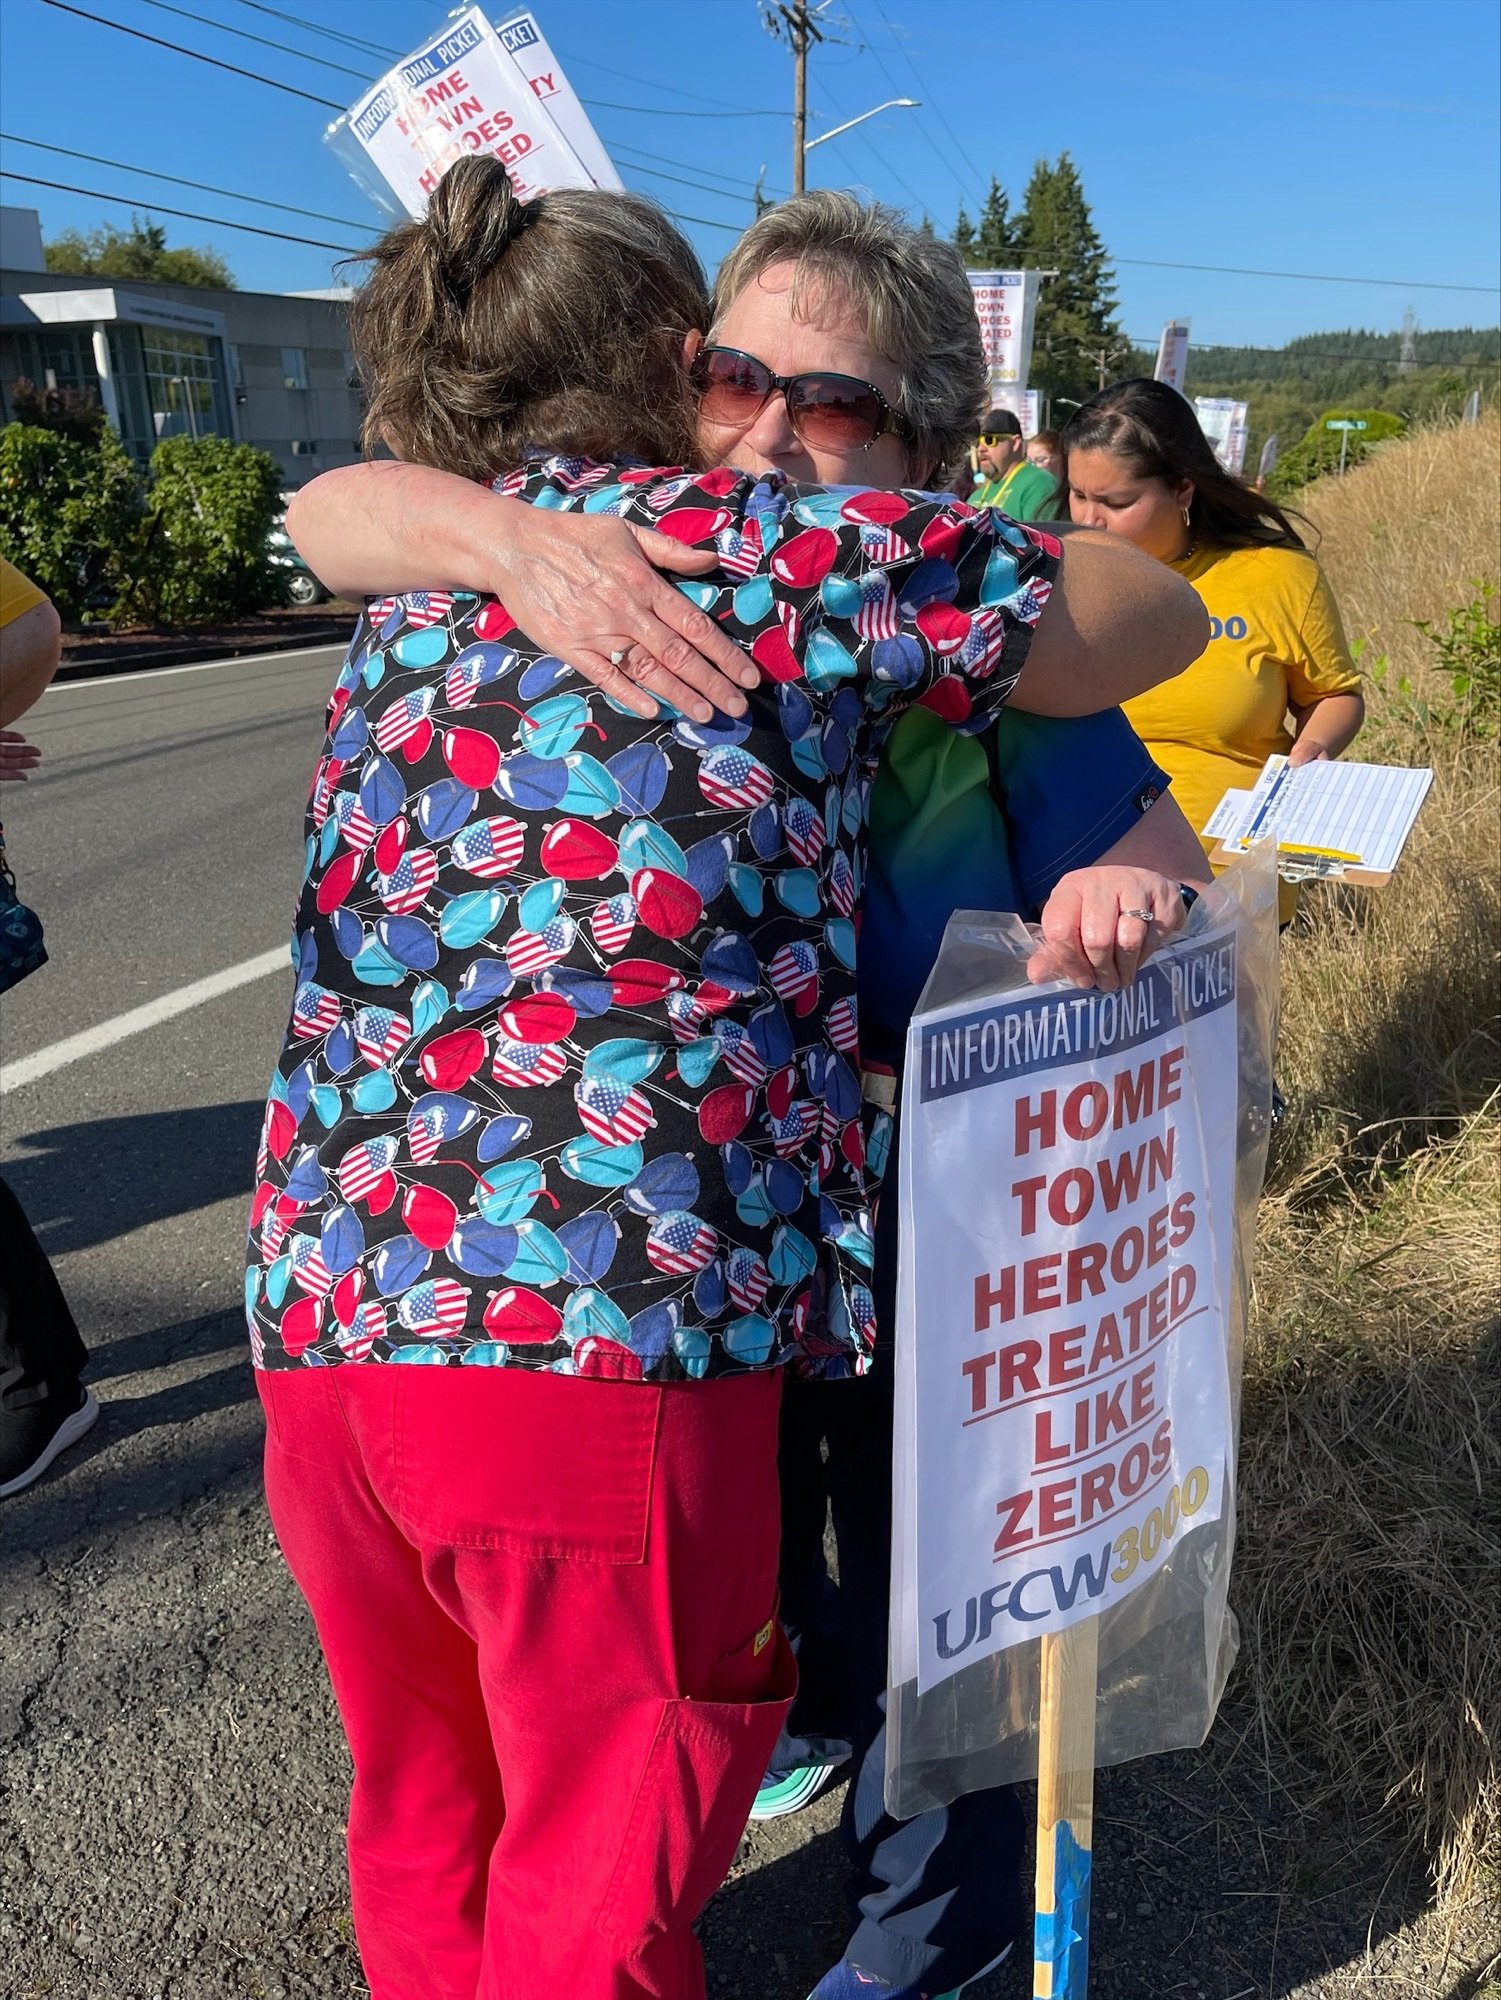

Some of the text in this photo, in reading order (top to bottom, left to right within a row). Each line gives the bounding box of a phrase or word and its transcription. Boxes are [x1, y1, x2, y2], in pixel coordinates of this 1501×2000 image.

[437, 22, 481, 66] PICKET
[502, 21, 535, 51] CKET
[976, 303, 1004, 313] OWN
[980, 315, 1011, 325] ROES
[983, 328, 1012, 338] ATED
[930, 942, 1236, 1089] INFORMATIONAL PICKET
[1014, 1046, 1185, 1158] HOME
[1011, 1127, 1175, 1237] TOWN
[974, 1191, 1196, 1333] HEROES
[962, 1263, 1198, 1414] TREATED
[1034, 1361, 1156, 1466] LIKE
[993, 1418, 1172, 1554] ZEROS
